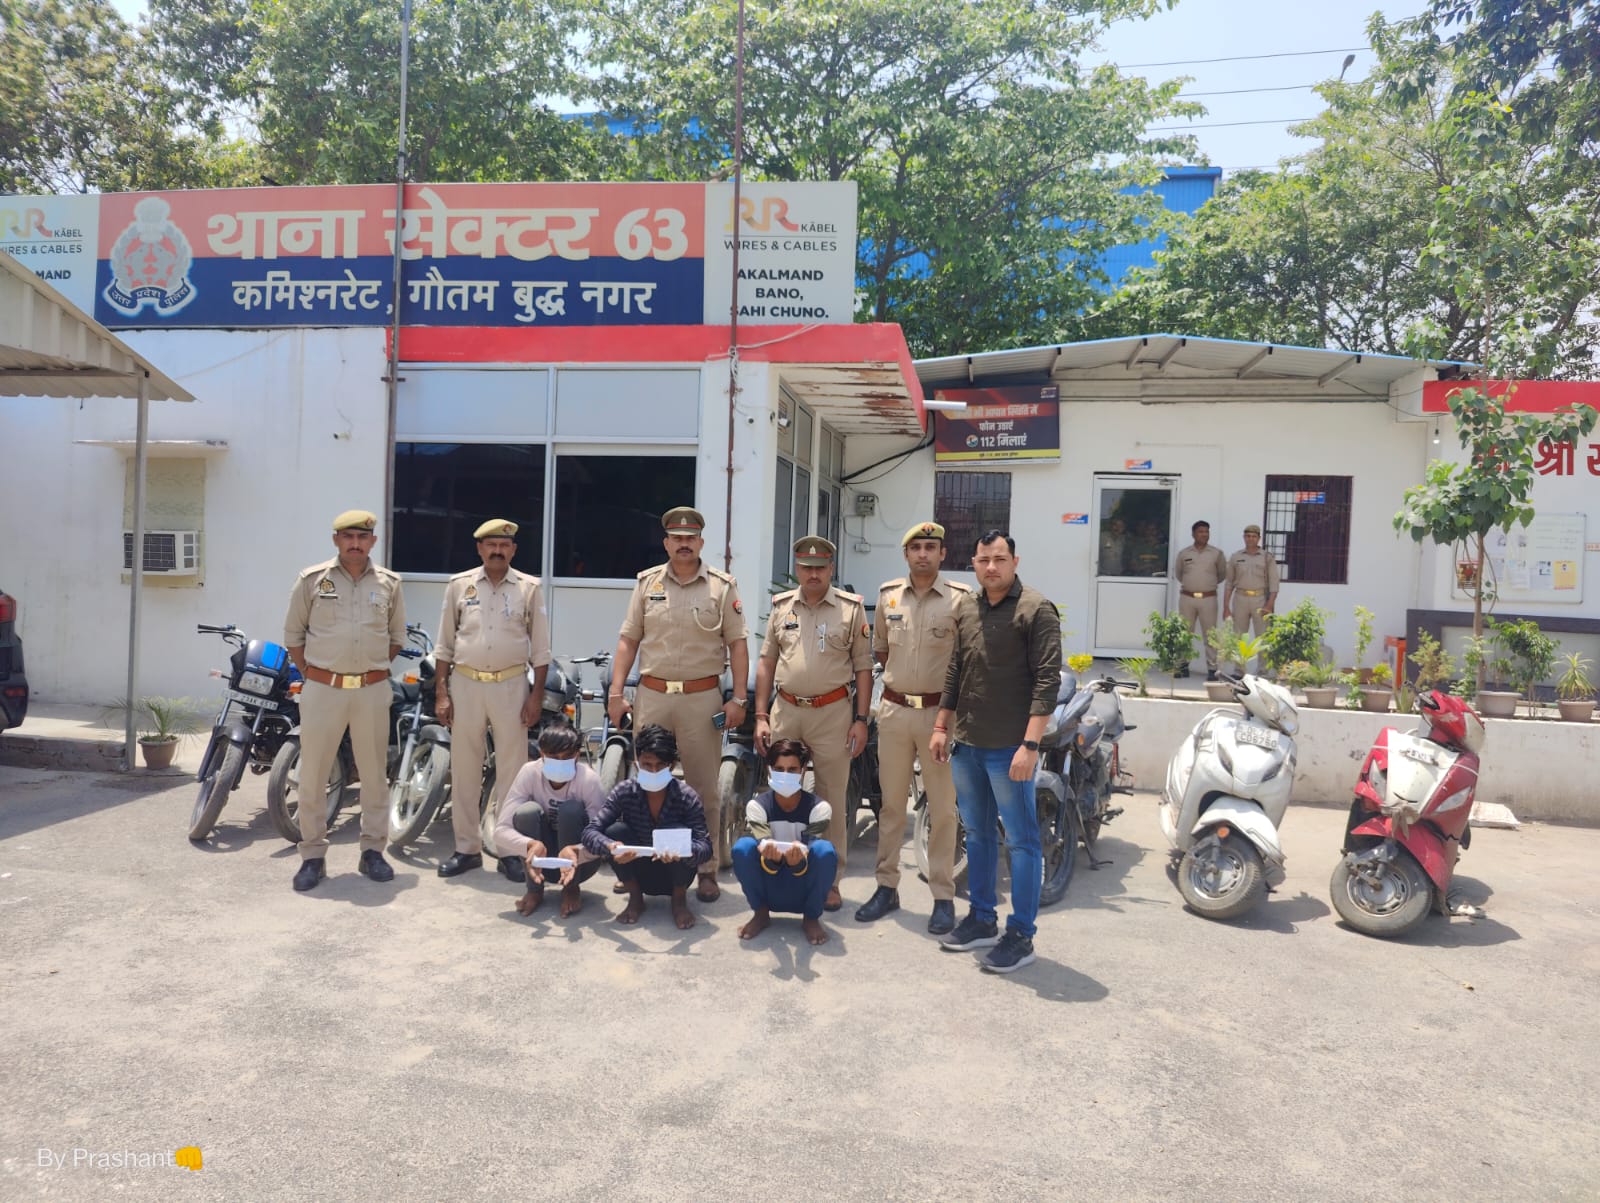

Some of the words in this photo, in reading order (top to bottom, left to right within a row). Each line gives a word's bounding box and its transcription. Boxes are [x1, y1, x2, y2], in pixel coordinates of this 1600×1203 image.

[207, 209, 366, 260] थाना
[382, 186, 600, 262] सेक्टर
[614, 208, 688, 261] 63
[30, 245, 38, 255] &
[40, 244, 82, 254] CABLES
[724, 240, 767, 251] WIRES
[771, 240, 779, 251] &
[783, 240, 838, 252] CABLES
[737, 268, 824, 281] AKALMAND
[232, 269, 393, 314] कमिश्नरेट,
[407, 266, 500, 311] गौतम
[512, 281, 568, 322] बुद्ध
[579, 281, 657, 314] नगर
[755, 287, 804, 301] BANO,
[770, 305, 829, 319] CHUNO.
[980, 436, 995, 448] 112
